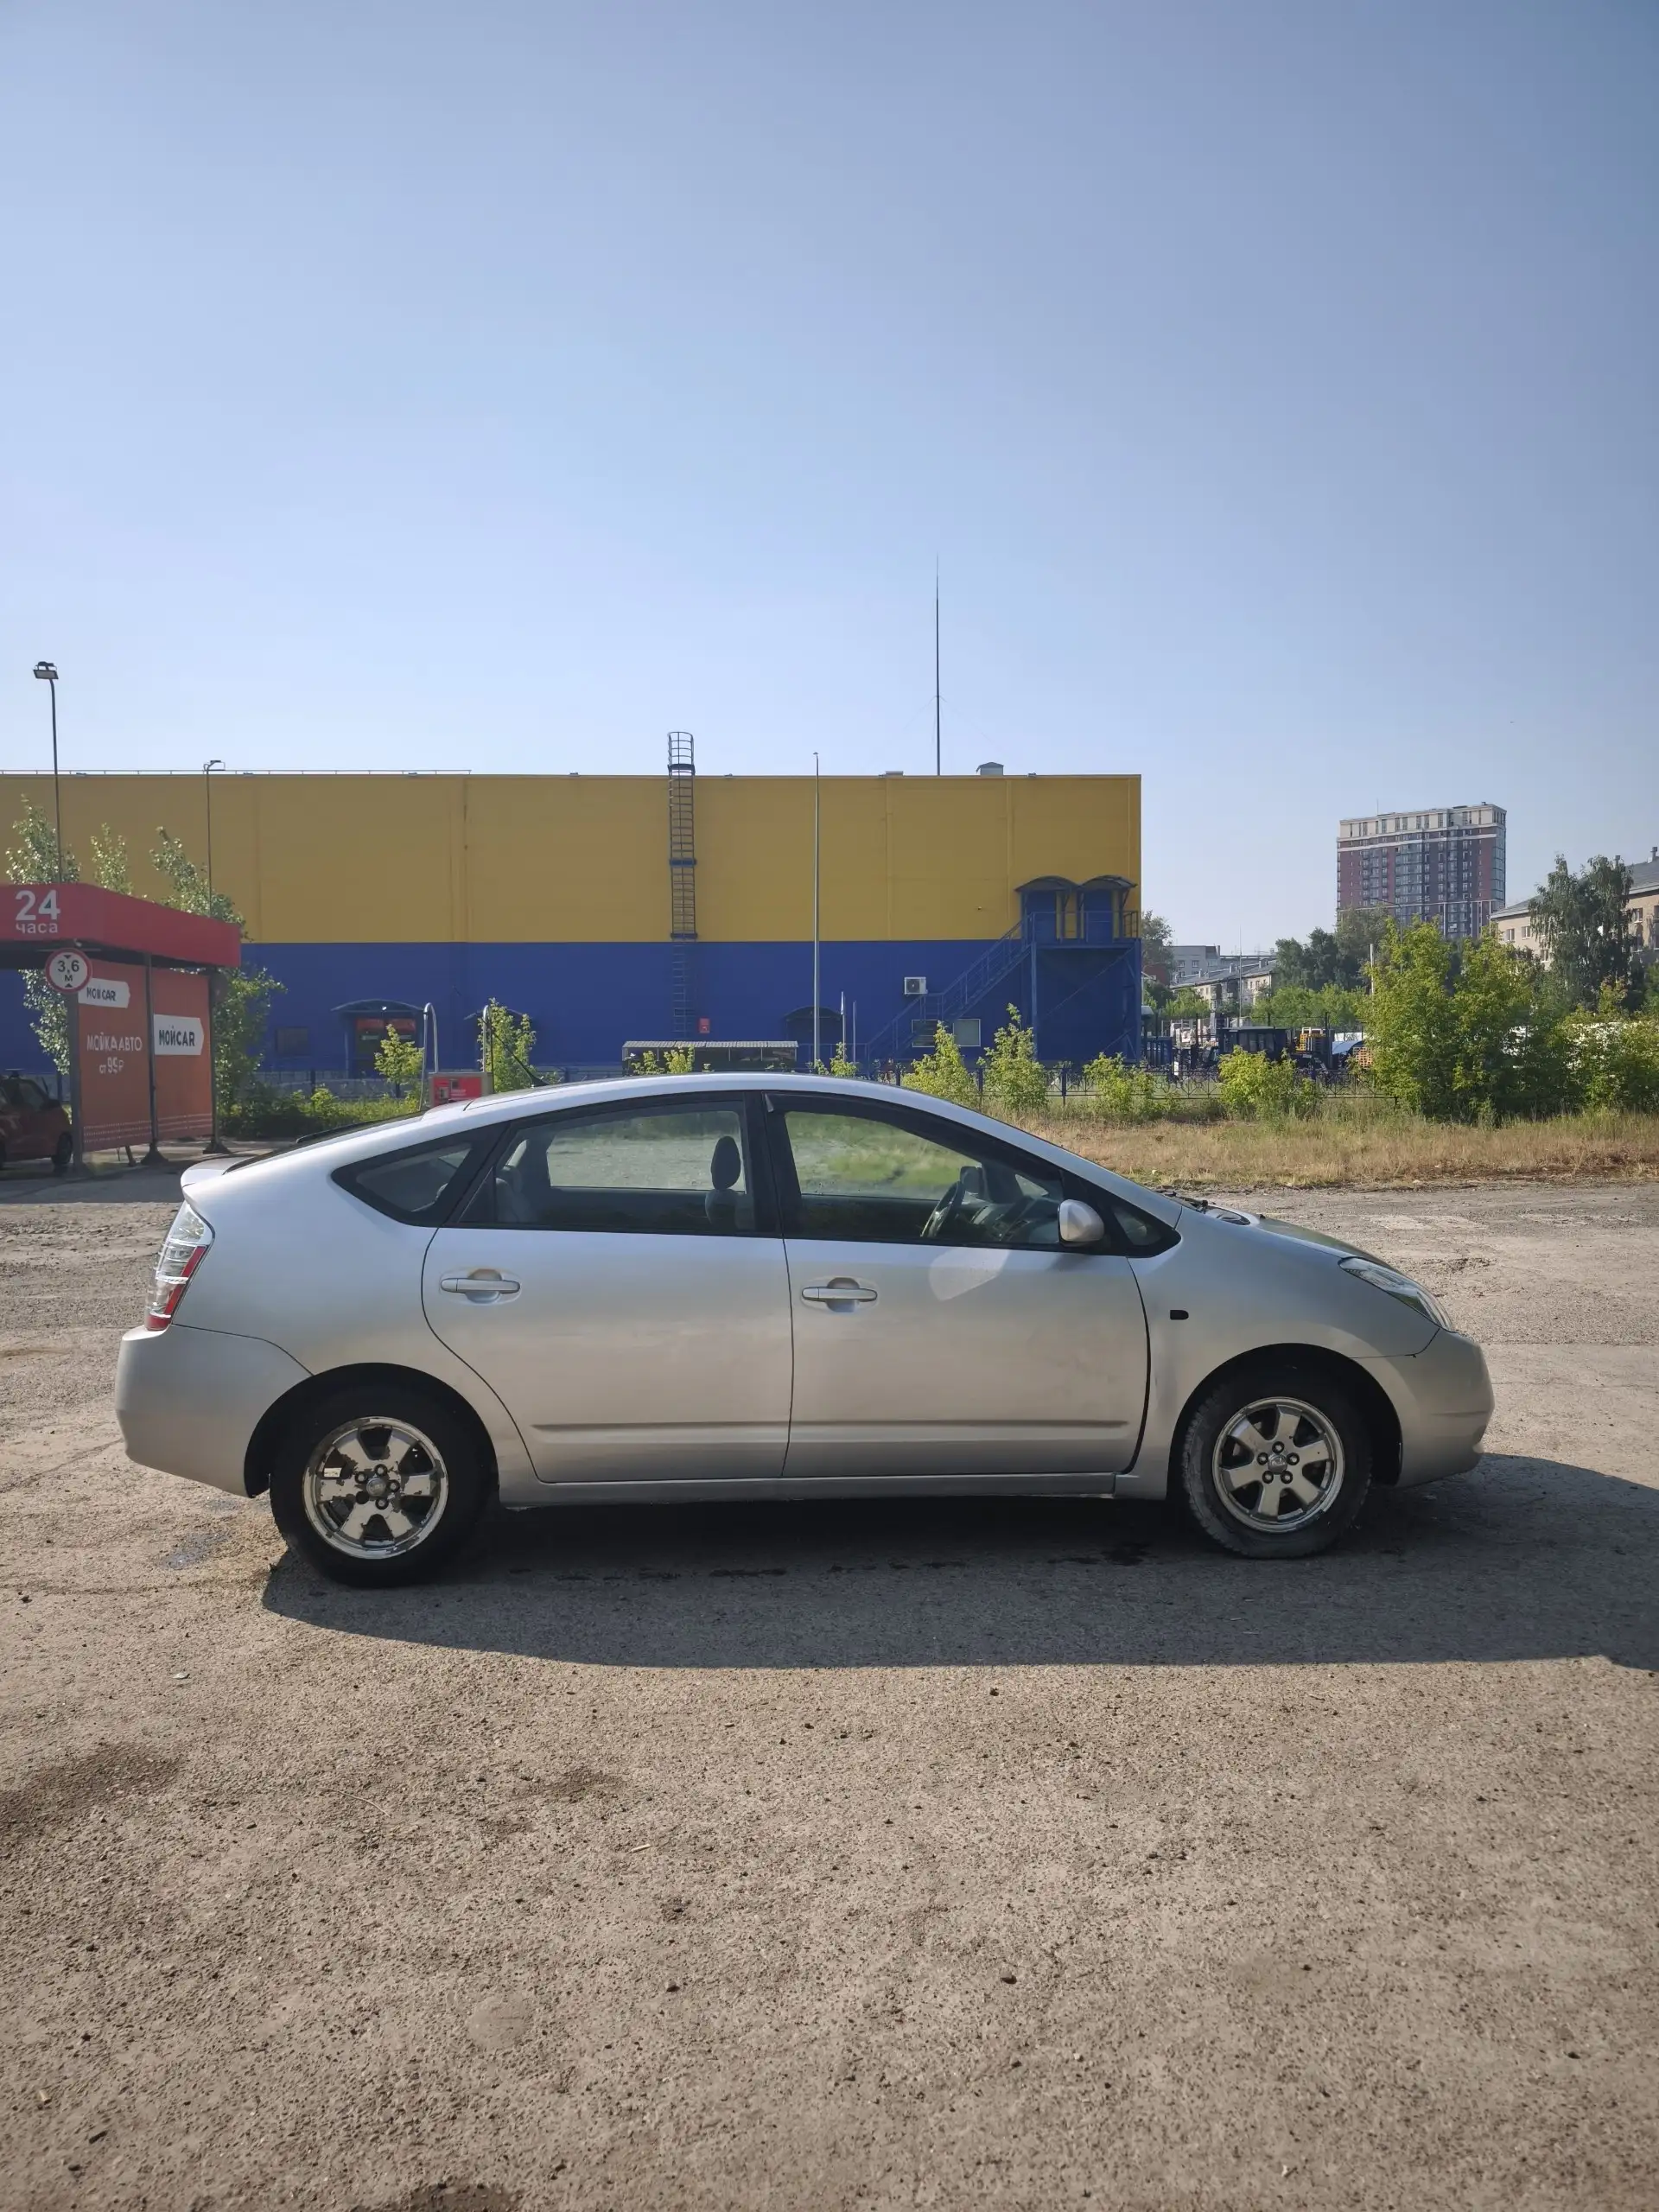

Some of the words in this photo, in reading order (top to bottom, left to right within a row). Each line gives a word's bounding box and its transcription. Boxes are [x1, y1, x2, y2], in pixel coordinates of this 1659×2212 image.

[15, 889, 61, 921] 24
[16, 922, 58, 934] часа
[57, 960, 79, 974] 3,6
[118, 1036, 143, 1052] АВТО
